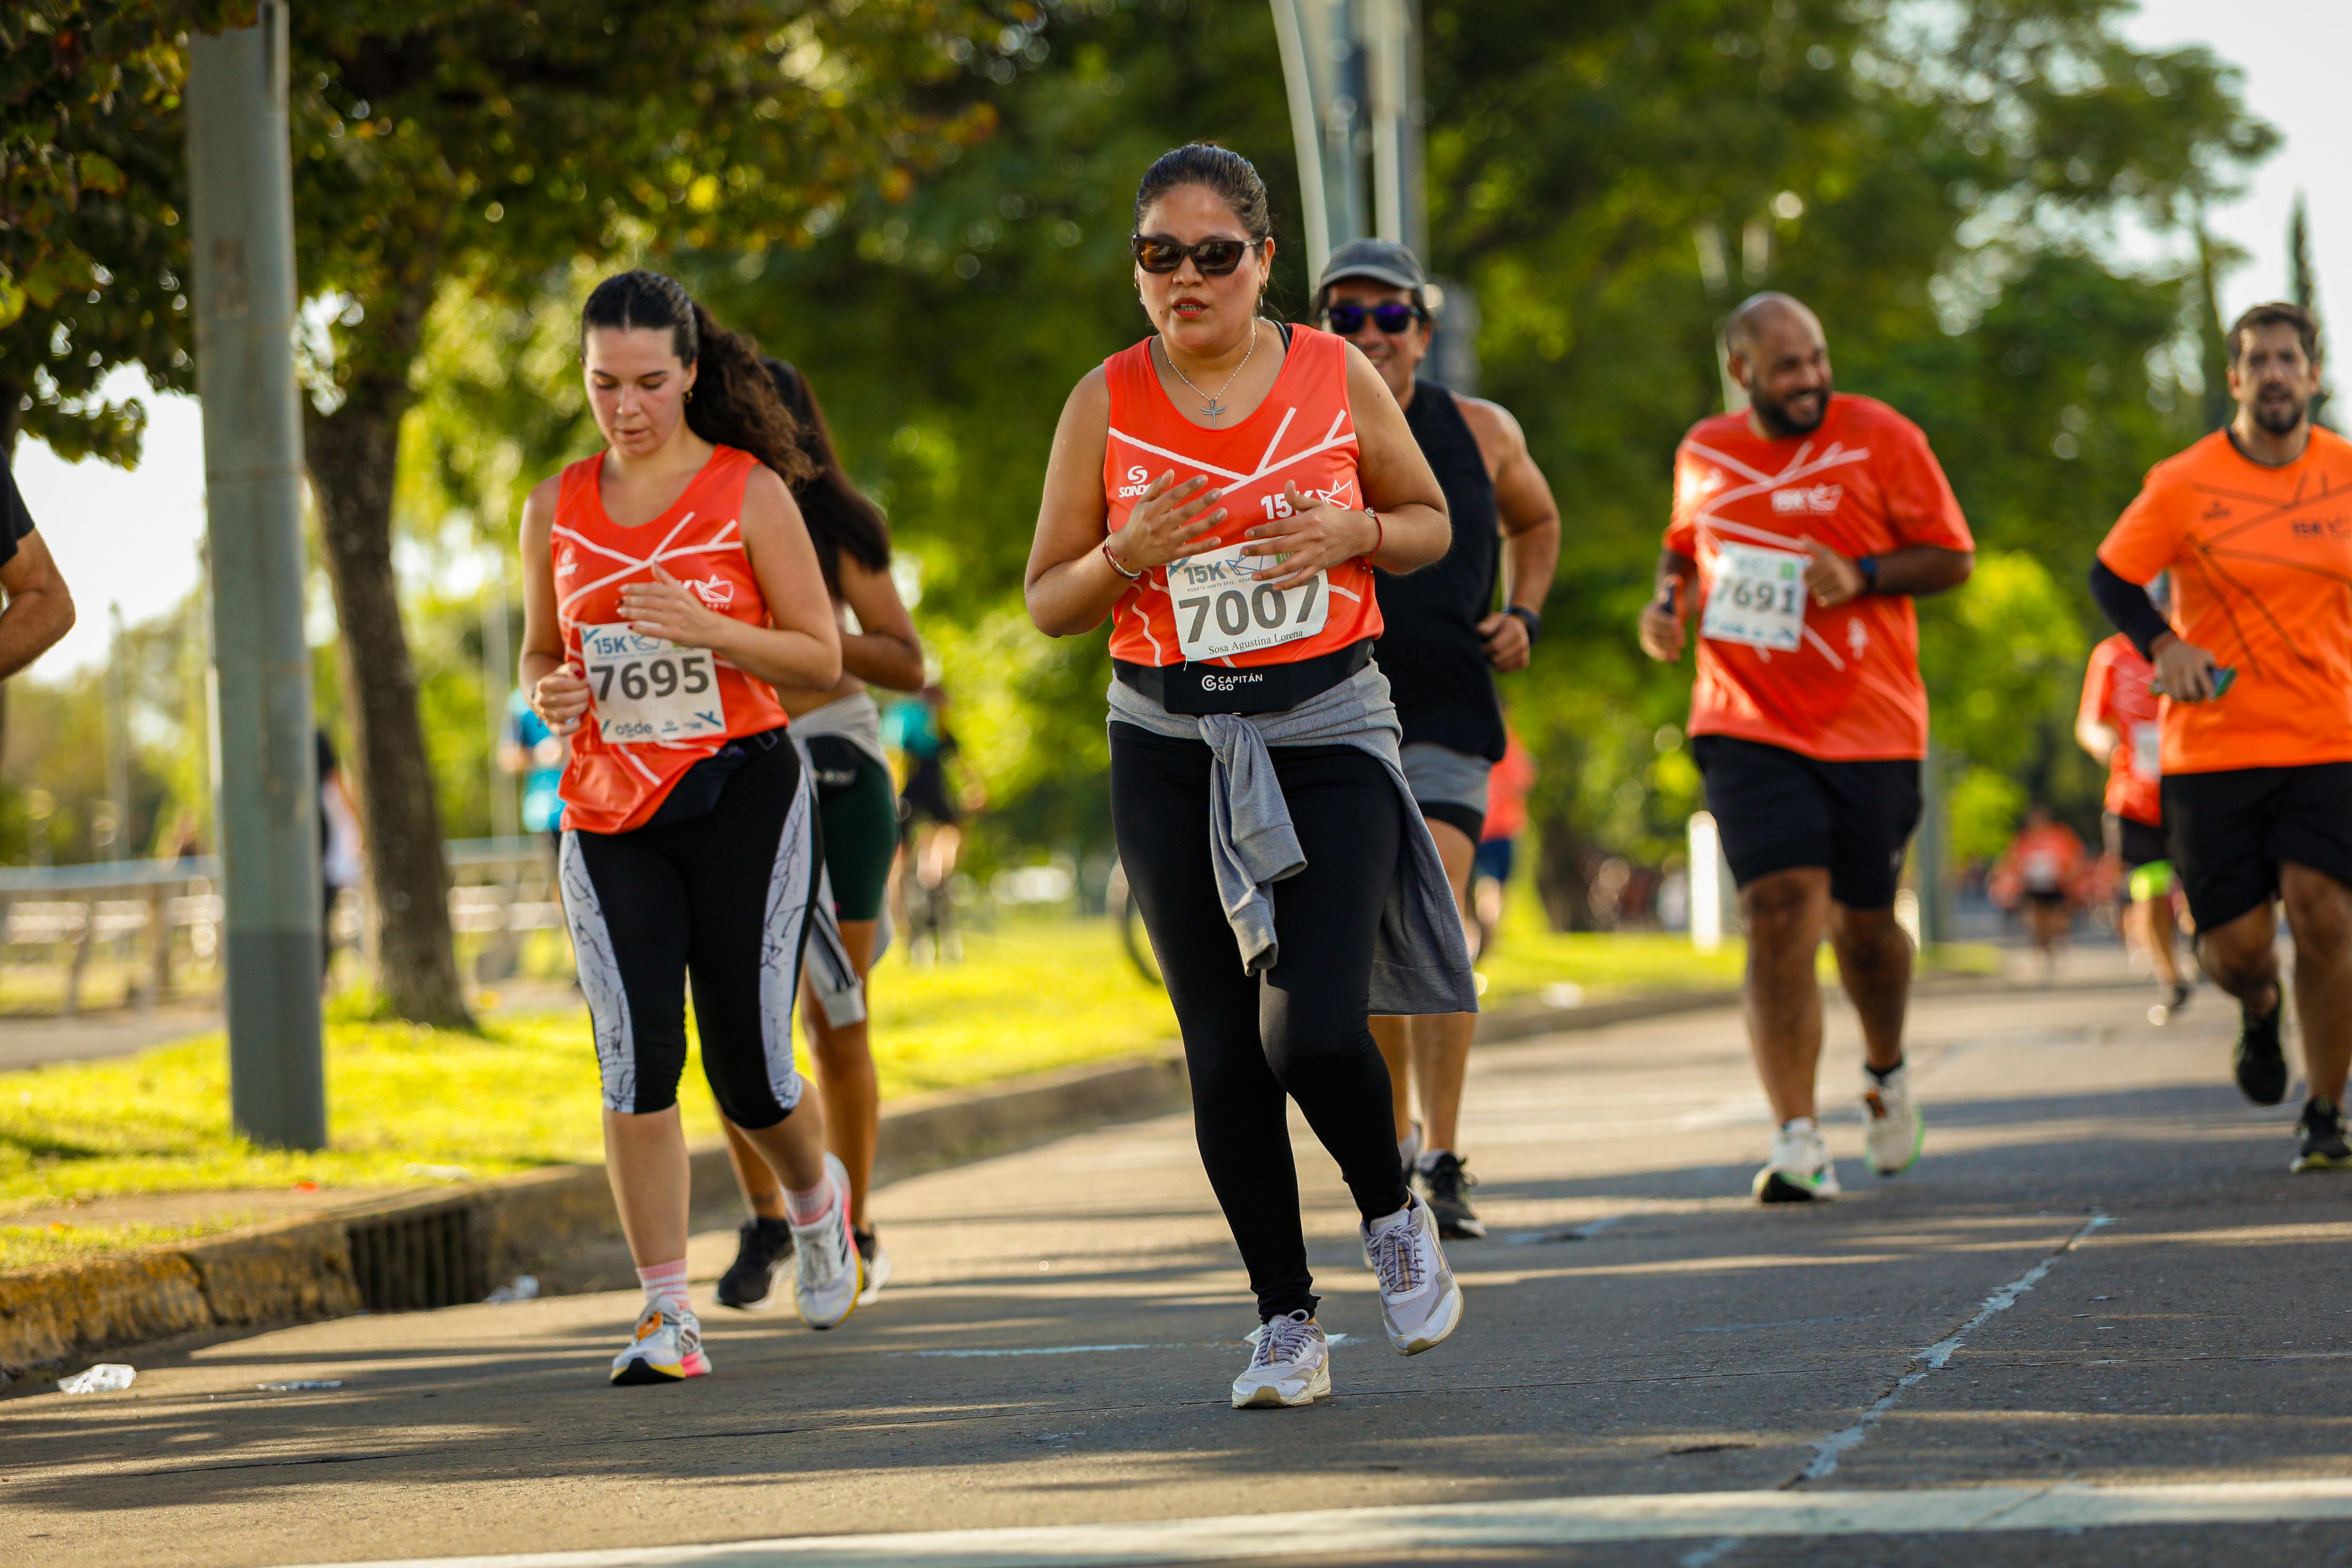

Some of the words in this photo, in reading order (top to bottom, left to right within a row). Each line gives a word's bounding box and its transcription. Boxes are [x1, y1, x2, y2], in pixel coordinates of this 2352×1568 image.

[1119, 484, 1151, 497] SOND
[1183, 561, 1227, 585] 15K
[1178, 575, 1320, 644] 7007
[594, 635, 628, 654] 15K
[1209, 645, 1229, 654] Sosa
[1232, 636, 1271, 651] Agustina
[1274, 630, 1303, 642] Lorena
[591, 657, 710, 701] 7695
[1218, 673, 1263, 684] CAPITÁN
[615, 721, 653, 737] osde
